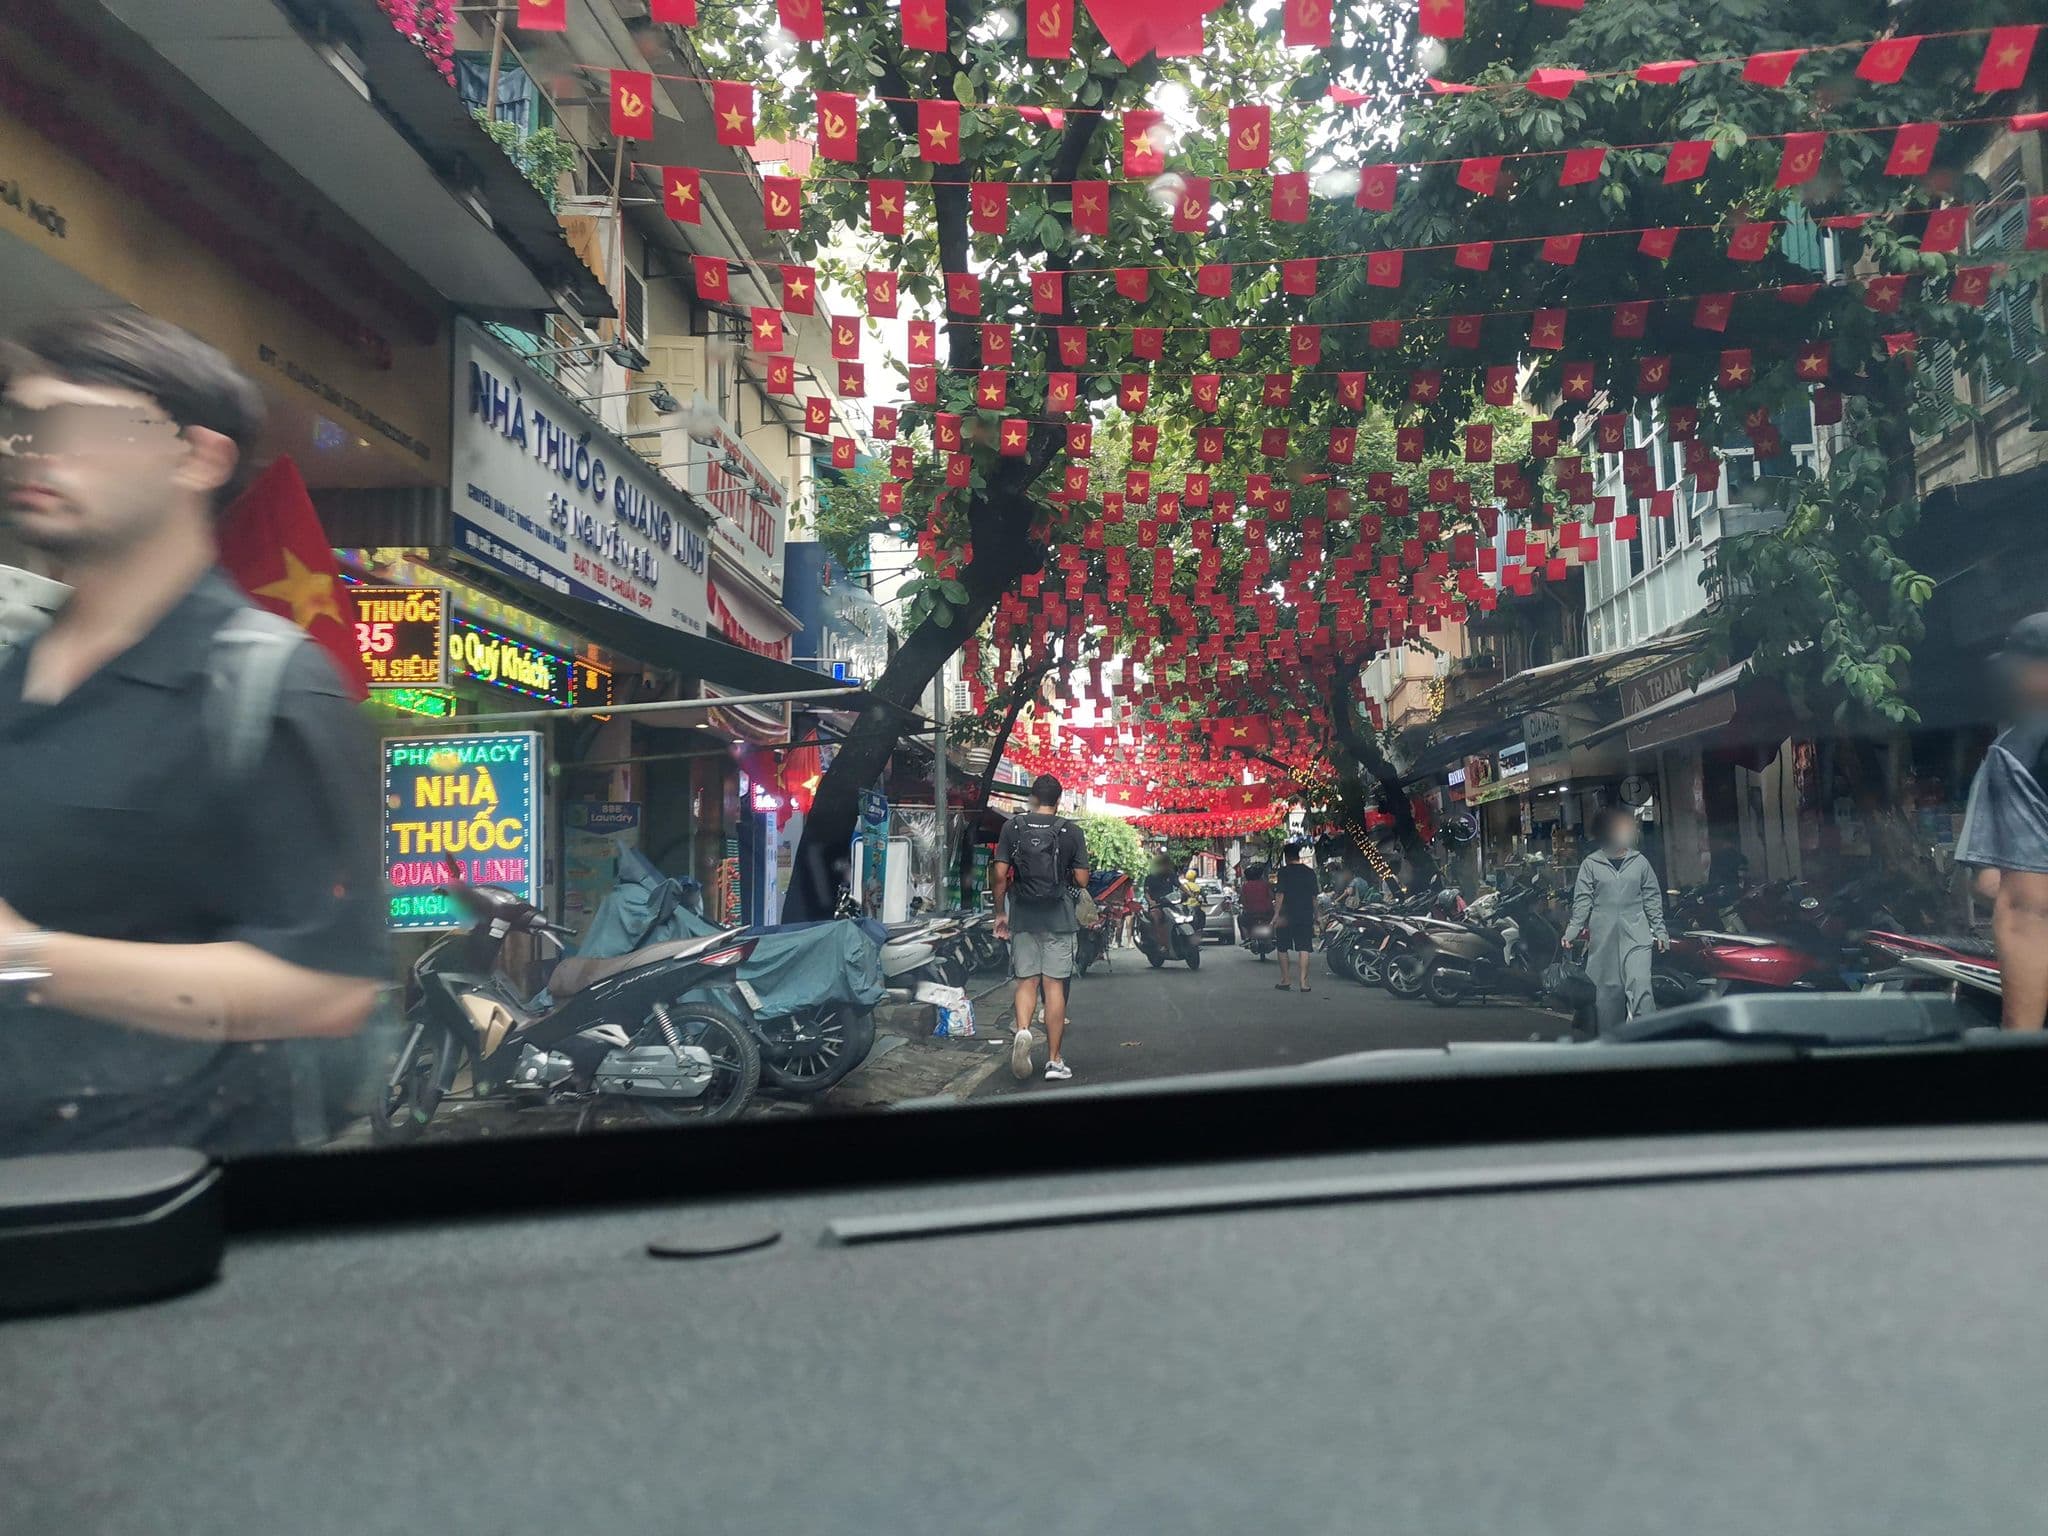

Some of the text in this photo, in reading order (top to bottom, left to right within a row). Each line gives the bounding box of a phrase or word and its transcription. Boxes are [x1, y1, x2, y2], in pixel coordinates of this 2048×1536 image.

[470, 361, 527, 450] NHÀ
[532, 409, 607, 504] THUỐC
[614, 475, 672, 551] QUANG
[672, 520, 705, 575] LINH
[549, 492, 568, 529] 35
[357, 592, 437, 622] THUỐC
[465, 632, 500, 681] Quý
[501, 644, 550, 690] Khách
[415, 766, 499, 808] NHÀ
[391, 804, 524, 854] THUỐC
[590, 813, 633, 824] Laundry
[472, 857, 526, 884] LINH
[390, 895, 450, 917] 35 NGU
